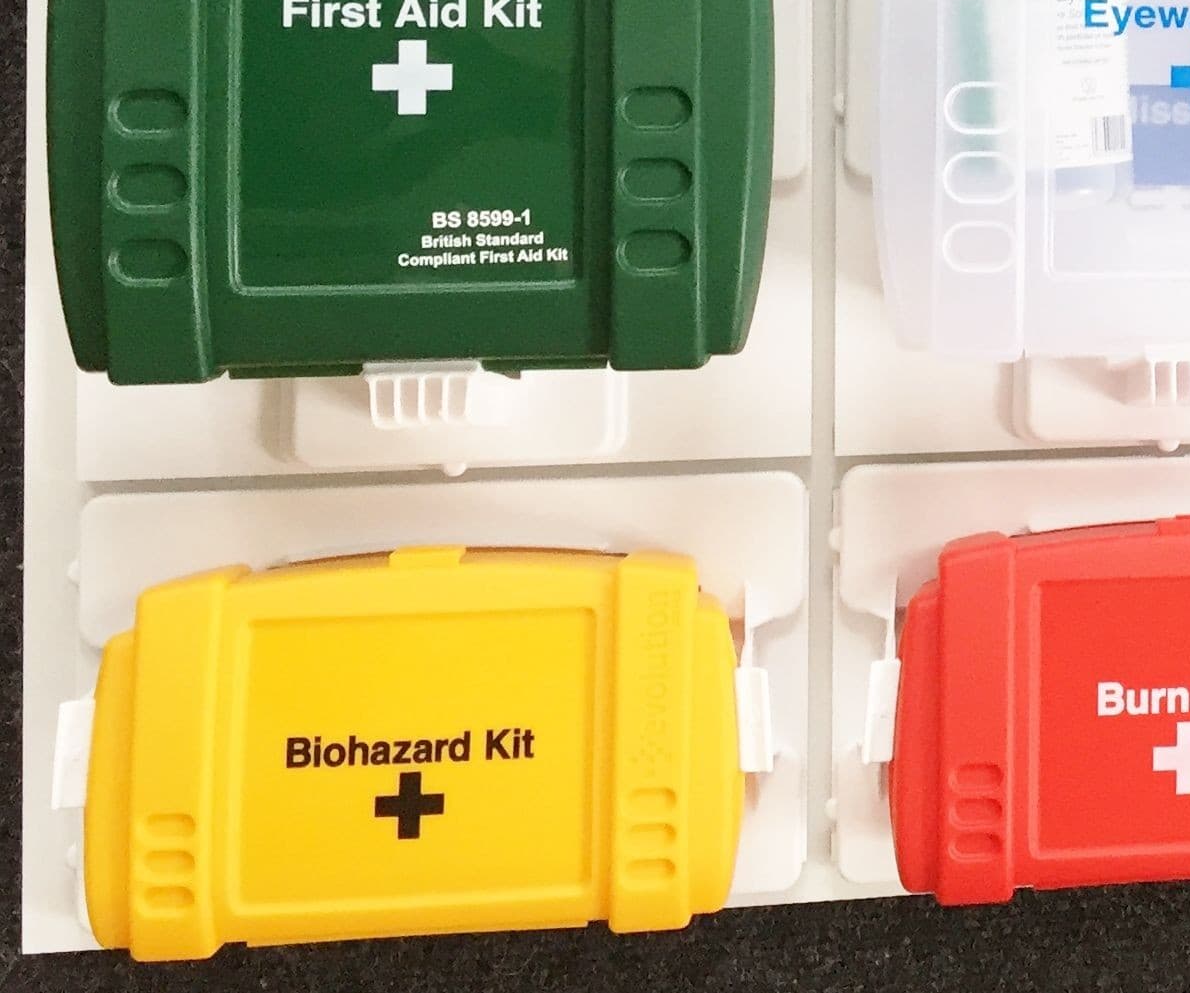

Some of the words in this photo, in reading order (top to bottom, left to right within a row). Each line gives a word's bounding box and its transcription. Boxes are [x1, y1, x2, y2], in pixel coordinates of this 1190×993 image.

[431, 211, 462, 229] BS
[466, 208, 532, 228] 8599-1
[421, 234, 472, 249] British
[475, 232, 544, 248] Standard
[397, 252, 476, 268] Compliant
[479, 250, 515, 264] First
[517, 249, 543, 263] Aid
[546, 248, 569, 262] Kit
[285, 730, 471, 769] Biohazard
[485, 728, 536, 761] Kit
